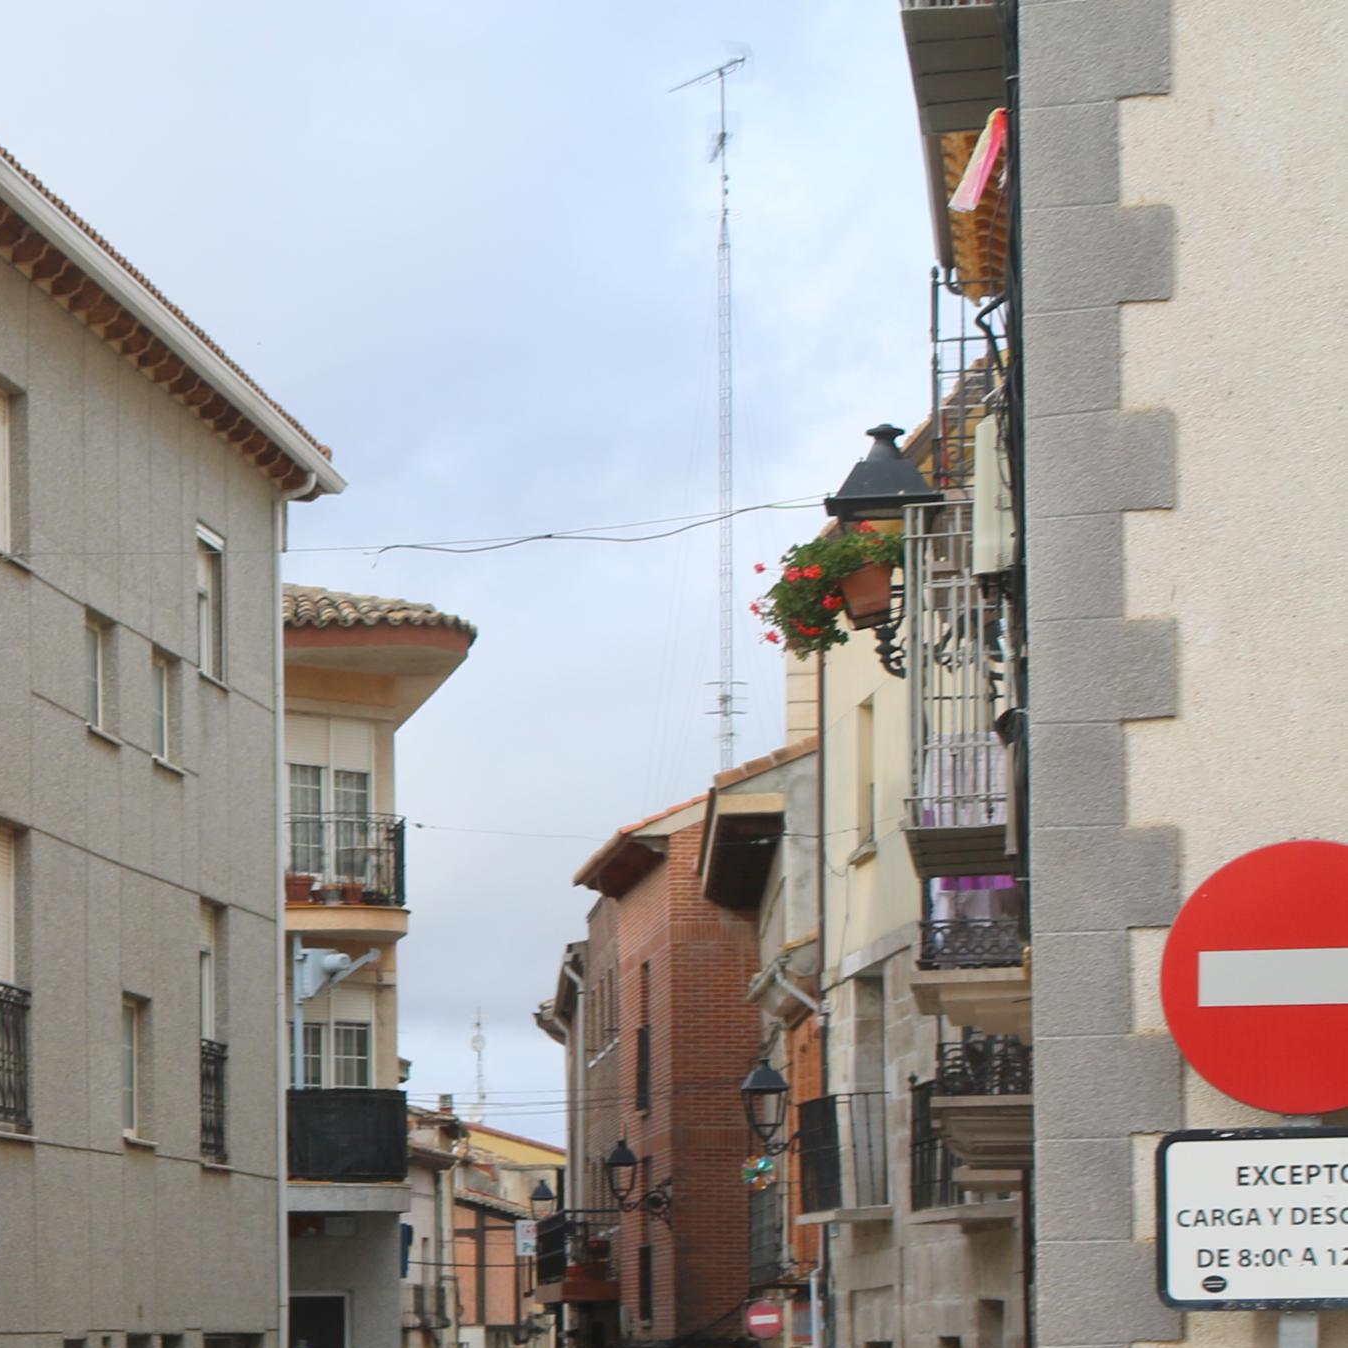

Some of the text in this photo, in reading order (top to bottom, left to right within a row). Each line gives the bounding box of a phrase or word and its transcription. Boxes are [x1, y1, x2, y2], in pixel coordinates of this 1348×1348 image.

[1176, 1207, 1261, 1227] CARGA
[1268, 1207, 1283, 1226] Y
[1197, 1249, 1230, 1268] DE
[1237, 1248, 1293, 1267] 8:00
[1300, 1247, 1318, 1267] A
